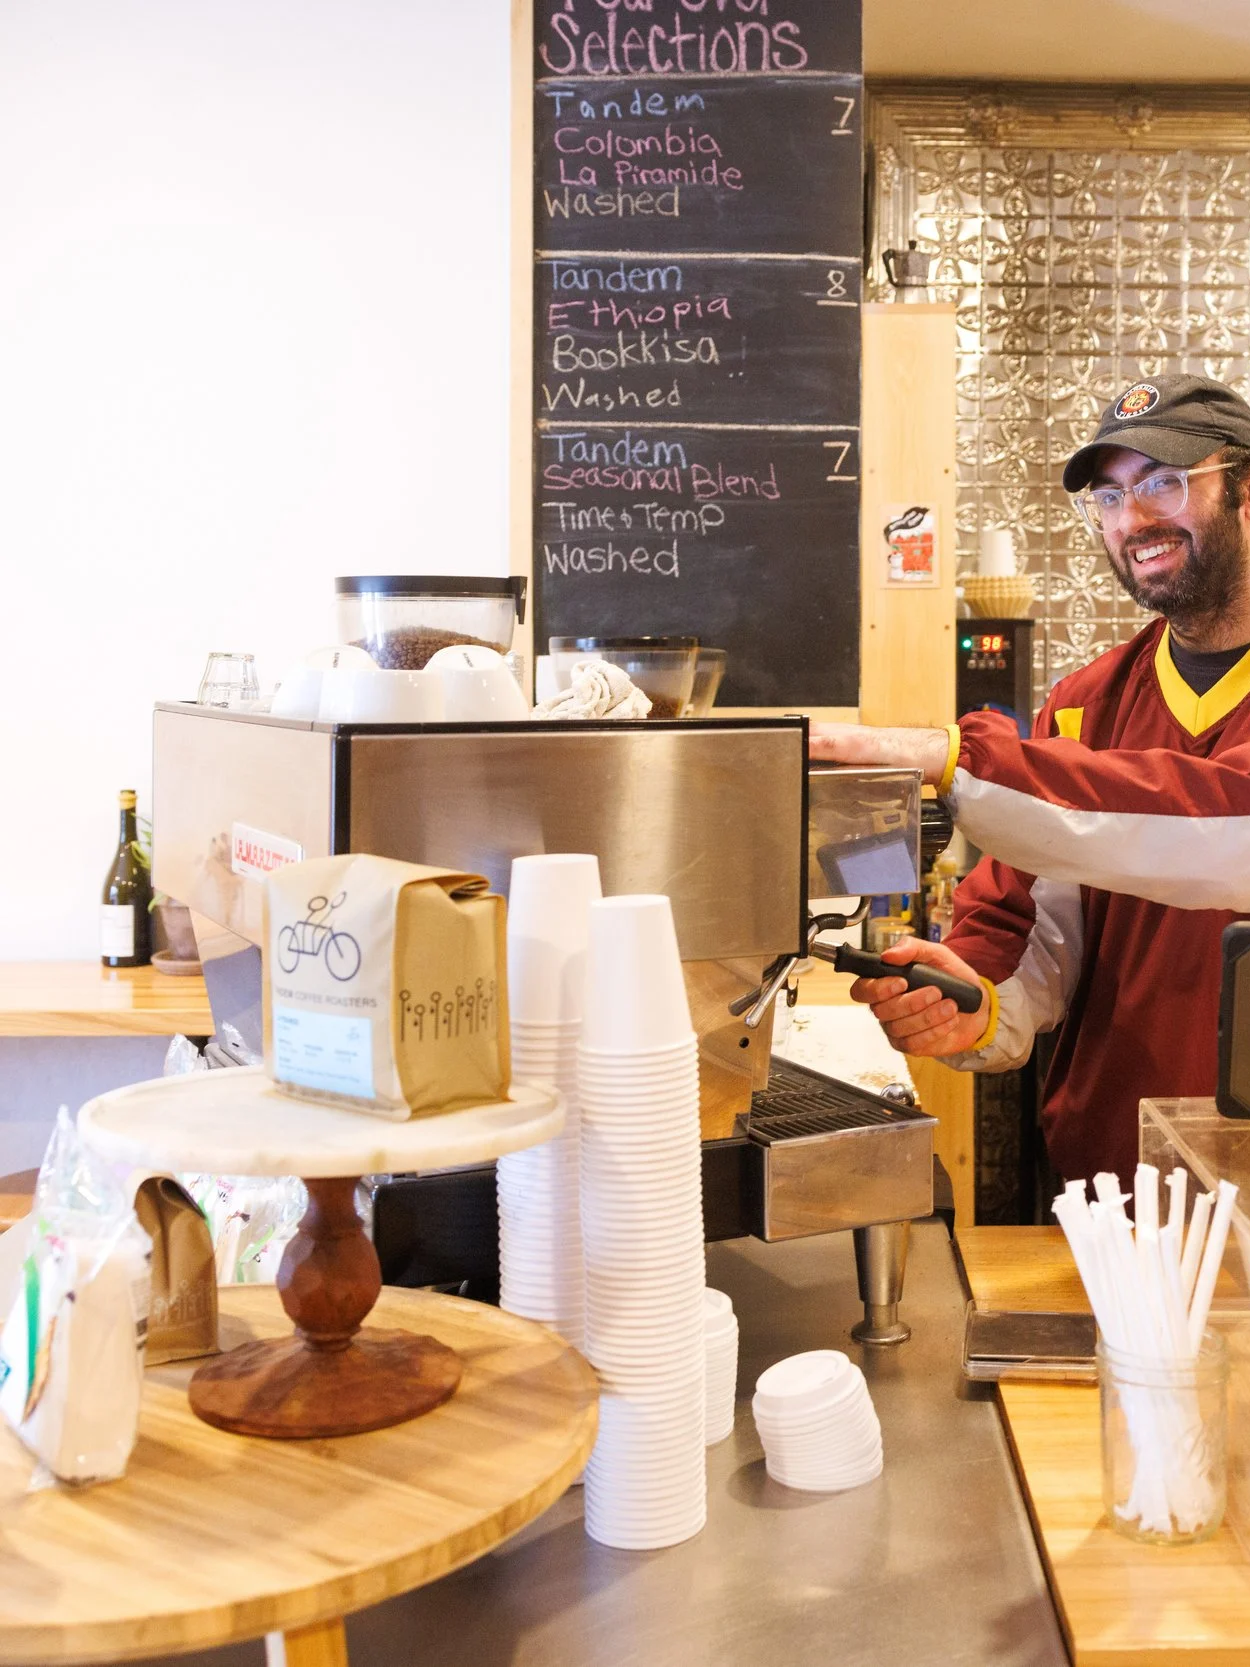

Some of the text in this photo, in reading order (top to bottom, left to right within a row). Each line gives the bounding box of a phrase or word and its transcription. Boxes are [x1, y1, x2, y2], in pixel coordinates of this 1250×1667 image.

[538, 12, 808, 75] Selections
[545, 89, 705, 119] Tandem
[833, 96, 855, 129] 7
[554, 124, 722, 158] Colombia
[559, 159, 744, 190] La Piramide
[544, 186, 680, 218] Washed
[540, 260, 683, 293] Tandem
[826, 270, 847, 298] 8
[549, 296, 732, 329] Ethiopia
[553, 329, 720, 372] Bookkisa
[542, 378, 682, 411] Washed
[541, 431, 687, 469] Tandem
[823, 441, 851, 473] 7
[543, 463, 780, 500] Seasonal Blend
[544, 539, 680, 578] Washed
[981, 636, 1002, 651] 98
